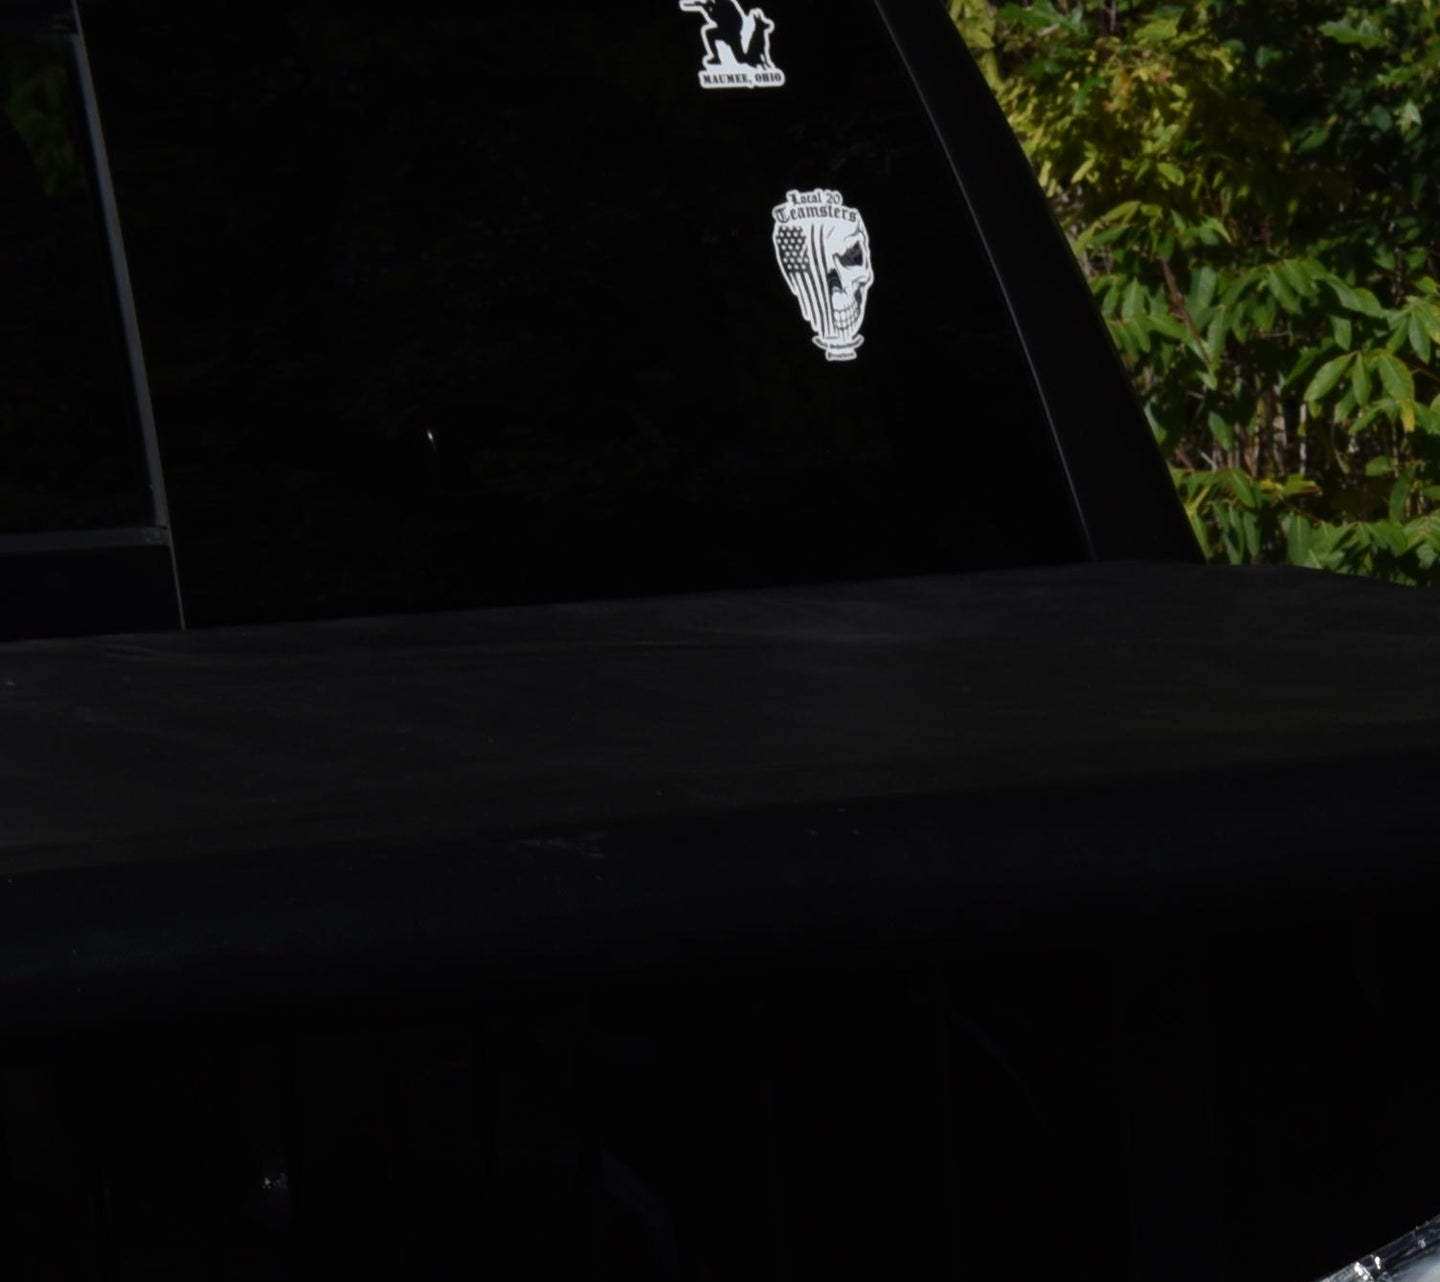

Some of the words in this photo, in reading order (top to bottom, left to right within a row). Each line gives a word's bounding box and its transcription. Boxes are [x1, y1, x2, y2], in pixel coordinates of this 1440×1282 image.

[703, 73, 752, 84] MAUMEE,
[755, 72, 781, 82] OHIO
[789, 191, 821, 205] Local
[826, 192, 841, 205] 20
[774, 205, 857, 223] Teamsters
